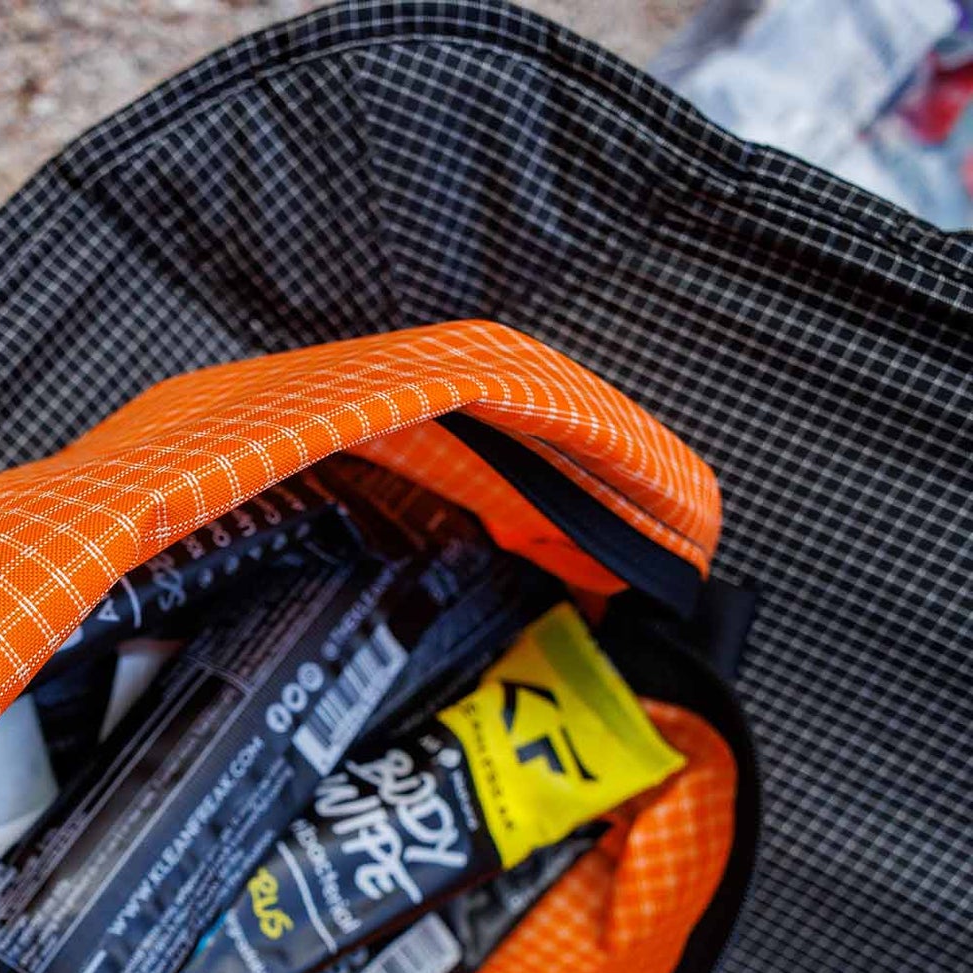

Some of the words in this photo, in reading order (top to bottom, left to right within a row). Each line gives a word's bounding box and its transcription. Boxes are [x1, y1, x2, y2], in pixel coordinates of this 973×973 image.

[315, 773, 423, 903] WIPE
[347, 749, 467, 868] BODY
[247, 867, 295, 939] RUS
